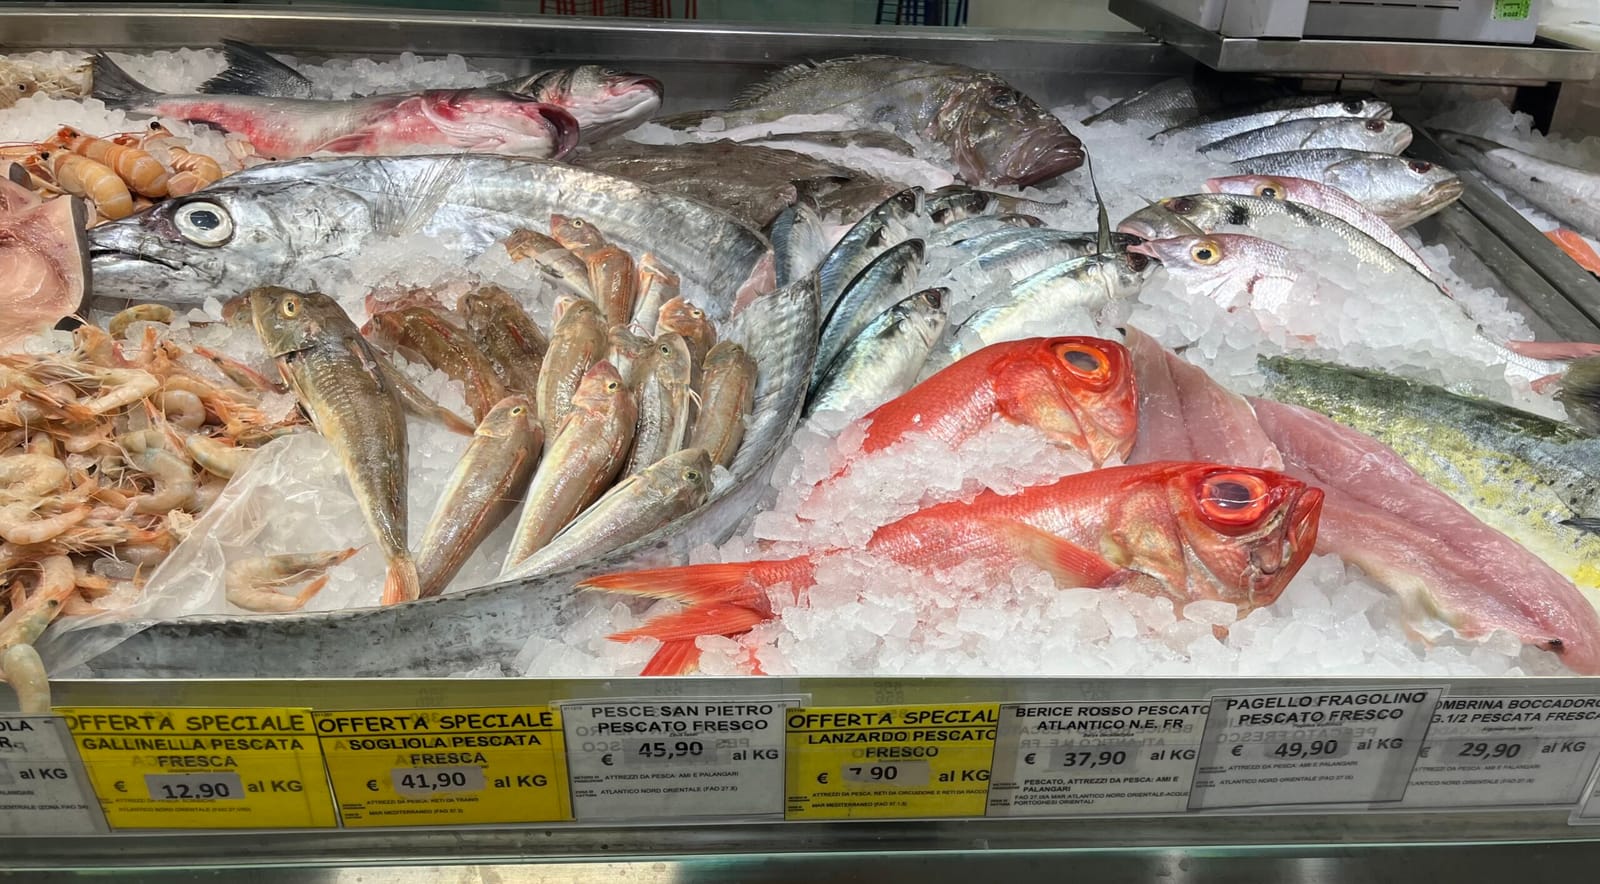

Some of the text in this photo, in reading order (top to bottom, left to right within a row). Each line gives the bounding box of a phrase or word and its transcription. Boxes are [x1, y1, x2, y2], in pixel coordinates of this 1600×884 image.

[1226, 691, 1428, 711] PAGELLO FRAGOLINO
[592, 706, 655, 718] PESCE
[660, 706, 699, 717] SAN
[705, 704, 773, 716] PIETRO
[1016, 706, 1073, 718] BERICE
[1077, 706, 1133, 717] ROSSO
[1138, 704, 1210, 716] PESCATO
[1238, 711, 1324, 725] PESCATO
[1329, 708, 1404, 721] FRESCO
[1470, 712, 1541, 723] PESCATA
[68, 714, 305, 731] OFFERTA SPECIALE
[319, 712, 554, 733] OFFERTA SPECIALE
[598, 719, 768, 734] PESCATO FRESCO
[788, 712, 893, 729] OFFERTA
[1037, 718, 1184, 731] ATLANTICO N.E. FR
[82, 738, 304, 751] GALLINELLA PESCATA
[349, 734, 541, 750] SOGLIOLA PESCATA
[808, 729, 996, 745] LANZARDO PESCATO
[601, 741, 779, 766] € 45,90 al KG
[866, 746, 938, 759] FRESCO
[1231, 738, 1403, 759] € 49,90 al KG
[1458, 742, 1521, 760] 29,90
[1541, 742, 1557, 753] al
[1560, 741, 1586, 753] KG
[157, 755, 238, 768] FRESCA
[411, 752, 488, 765] FRESCA
[1024, 749, 1196, 769] € 37,90 al KG
[19, 768, 68, 780] al KG
[366, 771, 548, 792] € 41,90 al KG
[817, 772, 829, 785] €
[938, 770, 956, 782] al
[962, 769, 990, 782] KG
[1024, 778, 1066, 787] PESCATO,
[1067, 777, 1108, 785] ATTREZZI
[1122, 776, 1154, 784] PESCA:
[1155, 775, 1173, 783] AMI
[114, 780, 128, 793] €
[247, 780, 265, 793] al
[271, 780, 303, 793] KG
[1058, 798, 1095, 806] ORIENTALI
[1067, 792, 1104, 800] ATLANTICO
